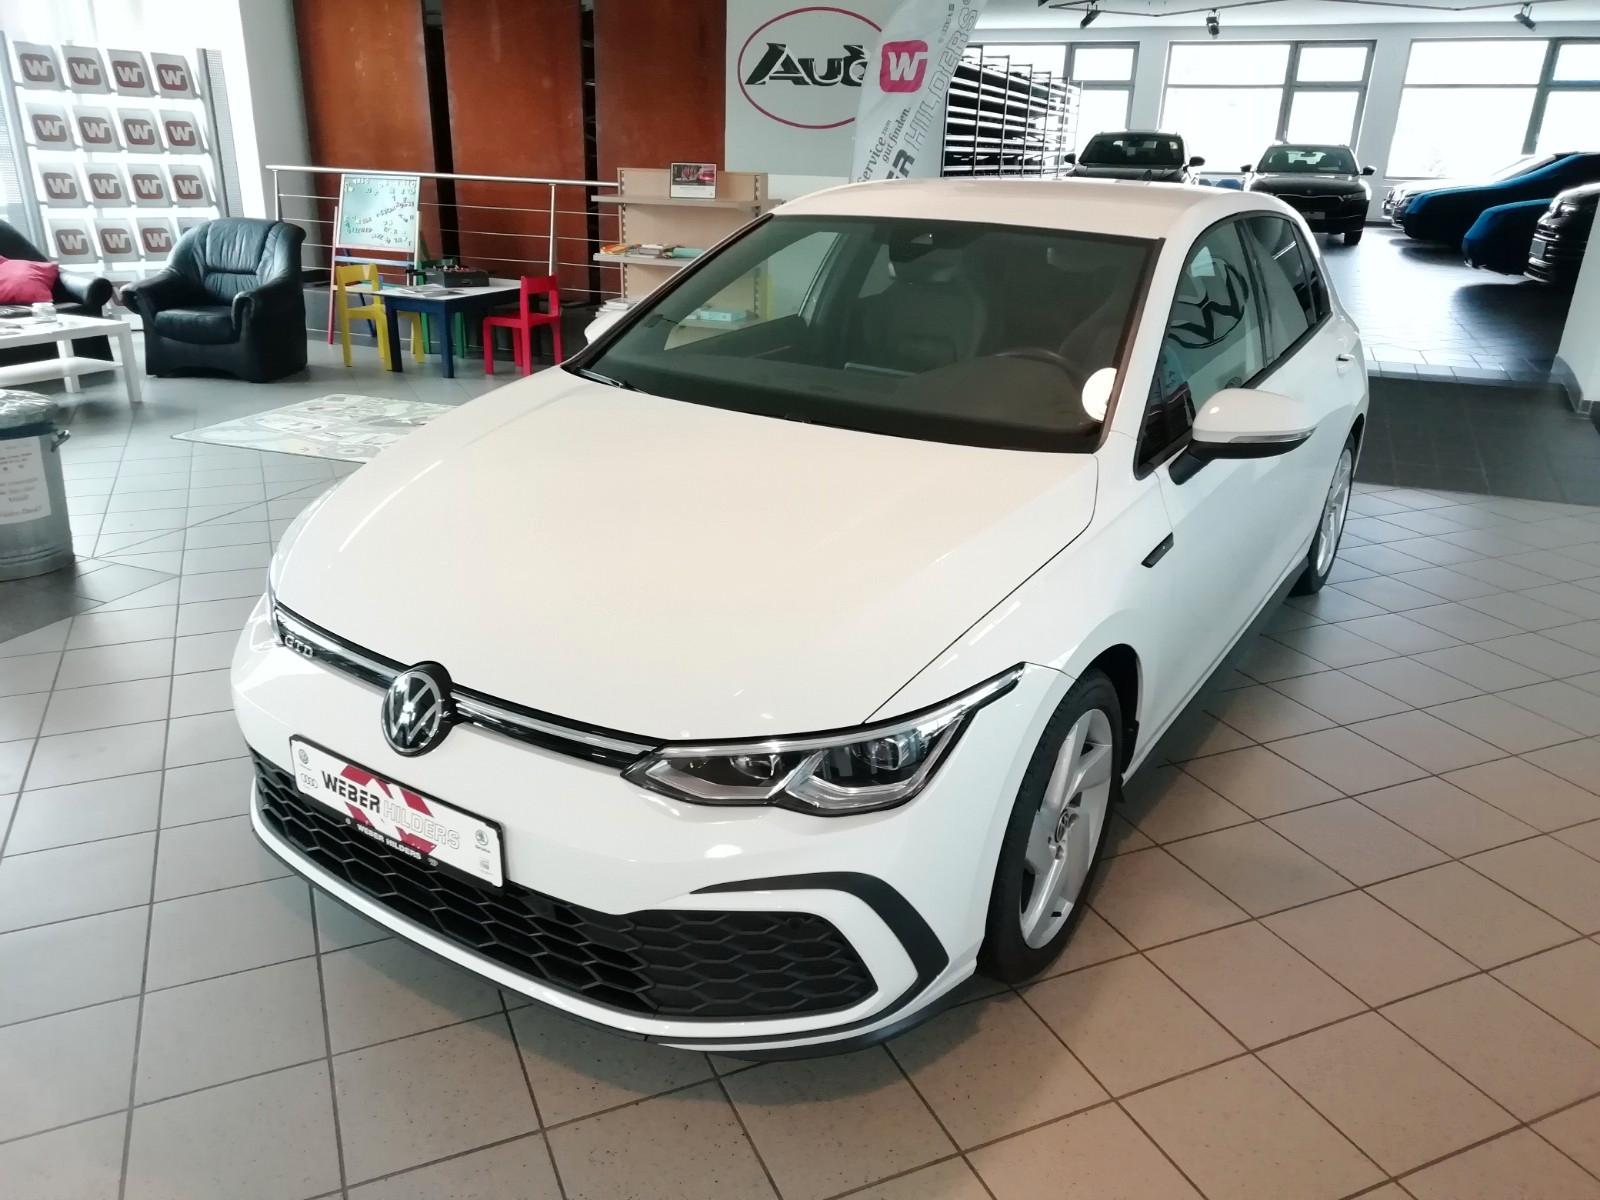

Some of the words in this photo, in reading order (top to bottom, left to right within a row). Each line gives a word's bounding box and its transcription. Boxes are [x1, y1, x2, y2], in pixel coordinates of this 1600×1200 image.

[745, 42, 868, 87] Aud
[882, 144, 893, 163] gut
[284, 635, 314, 658] GTD
[321, 770, 380, 814] WEBER
[383, 799, 461, 850] HILDERS
[357, 824, 386, 843] WEBER
[386, 837, 422, 860] HILDERS
